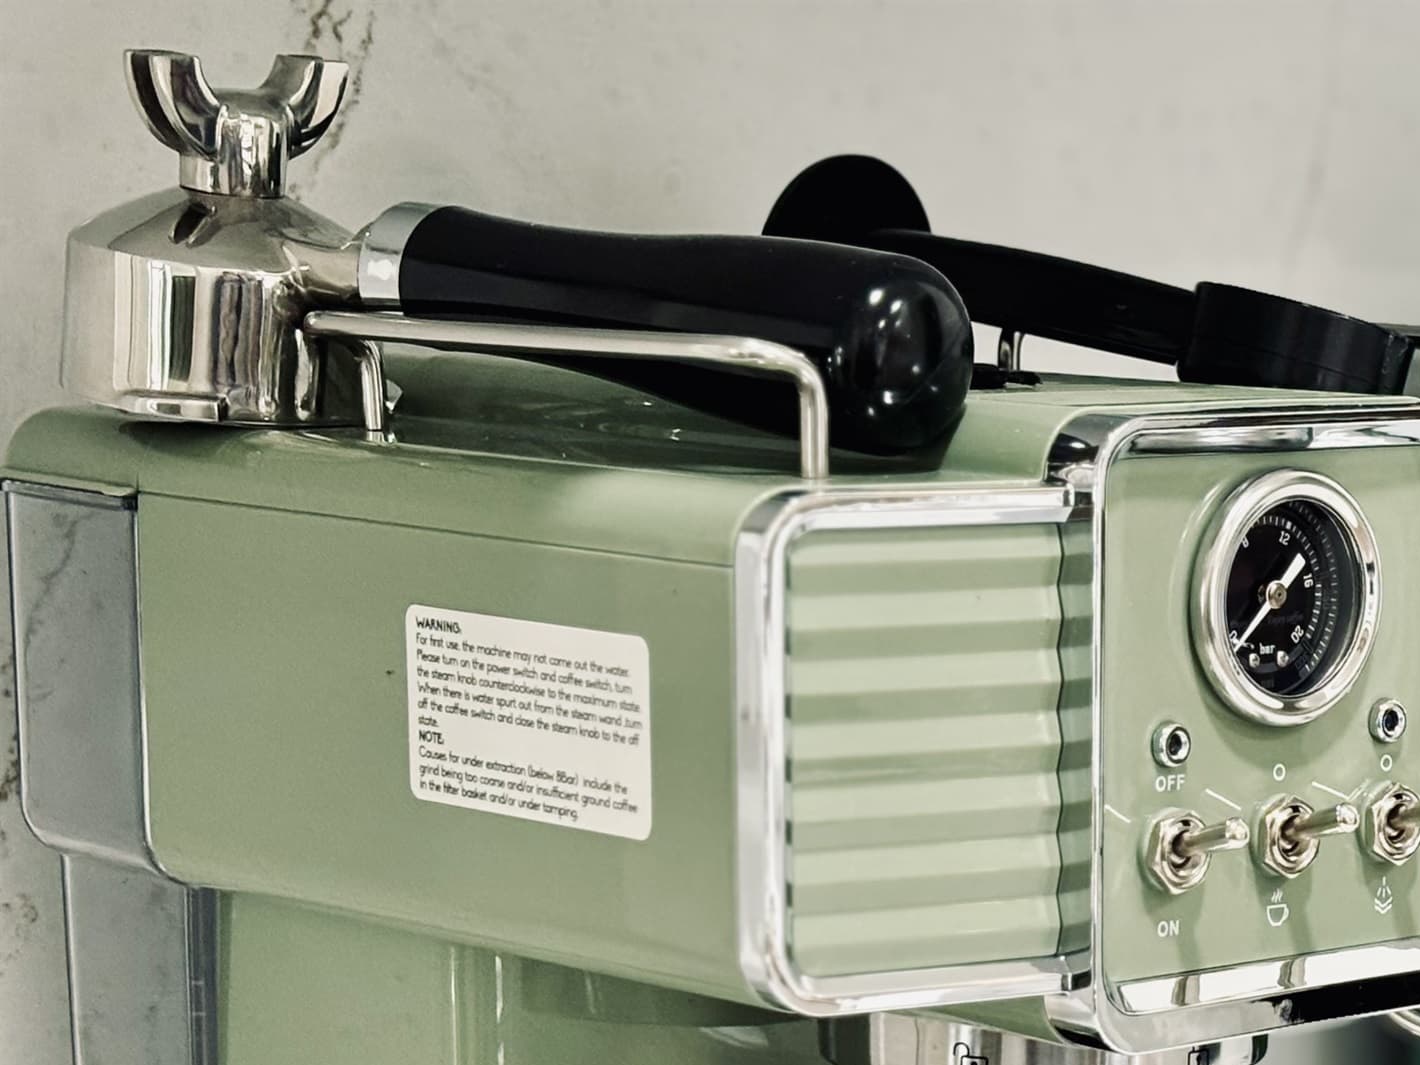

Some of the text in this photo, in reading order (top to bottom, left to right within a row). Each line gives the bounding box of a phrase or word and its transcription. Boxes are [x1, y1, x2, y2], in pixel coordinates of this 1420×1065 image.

[1278, 530, 1291, 546] 12
[1302, 572, 1314, 589] 16
[1259, 642, 1276, 655] bar
[1290, 625, 1305, 644] 20
[416, 632, 427, 645] For
[430, 635, 444, 648] first
[462, 640, 475, 653] the
[477, 645, 512, 658] machine
[513, 651, 532, 665] may
[534, 653, 547, 665] not
[549, 657, 572, 668] come
[574, 661, 588, 672] out
[590, 660, 603, 673] the
[417, 649, 440, 663] Please
[442, 654, 458, 667] turn
[460, 659, 470, 669] on
[472, 659, 485, 671] the
[487, 663, 511, 676] power
[513, 667, 538, 679] switch
[540, 670, 556, 682] and
[558, 673, 583, 686] coffee
[614, 682, 633, 694] turn
[417, 666, 430, 678] the
[431, 669, 455, 682] steam
[457, 671, 477, 686] knob
[548, 688, 557, 699] to
[558, 688, 571, 702] the
[573, 693, 617, 709] maximum
[417, 681, 440, 695] When
[443, 686, 462, 698] there
[464, 691, 470, 701] is
[472, 694, 494, 705] water
[496, 697, 517, 710] spurt
[518, 701, 532, 711] out
[534, 699, 554, 714] from
[556, 705, 569, 717] the
[571, 709, 597, 721] steam
[417, 698, 640, 745] off the coffee switch and close the steam knob to the off
[418, 745, 447, 761] Causes
[448, 751, 459, 763] for
[461, 756, 483, 767] under
[486, 761, 526, 776] extraction
[528, 764, 554, 780] (below
[583, 777, 612, 791] include
[614, 781, 628, 795] the
[1155, 774, 1185, 792] OFF
[419, 764, 638, 814] grind being too coarse and/or insufficient ground coffee
[419, 780, 427, 789] in
[428, 779, 442, 792] the
[443, 781, 459, 795] filter
[461, 787, 487, 800] basket
[489, 791, 515, 806] and/or
[518, 798, 541, 810] under
[1157, 920, 1179, 938] ON
